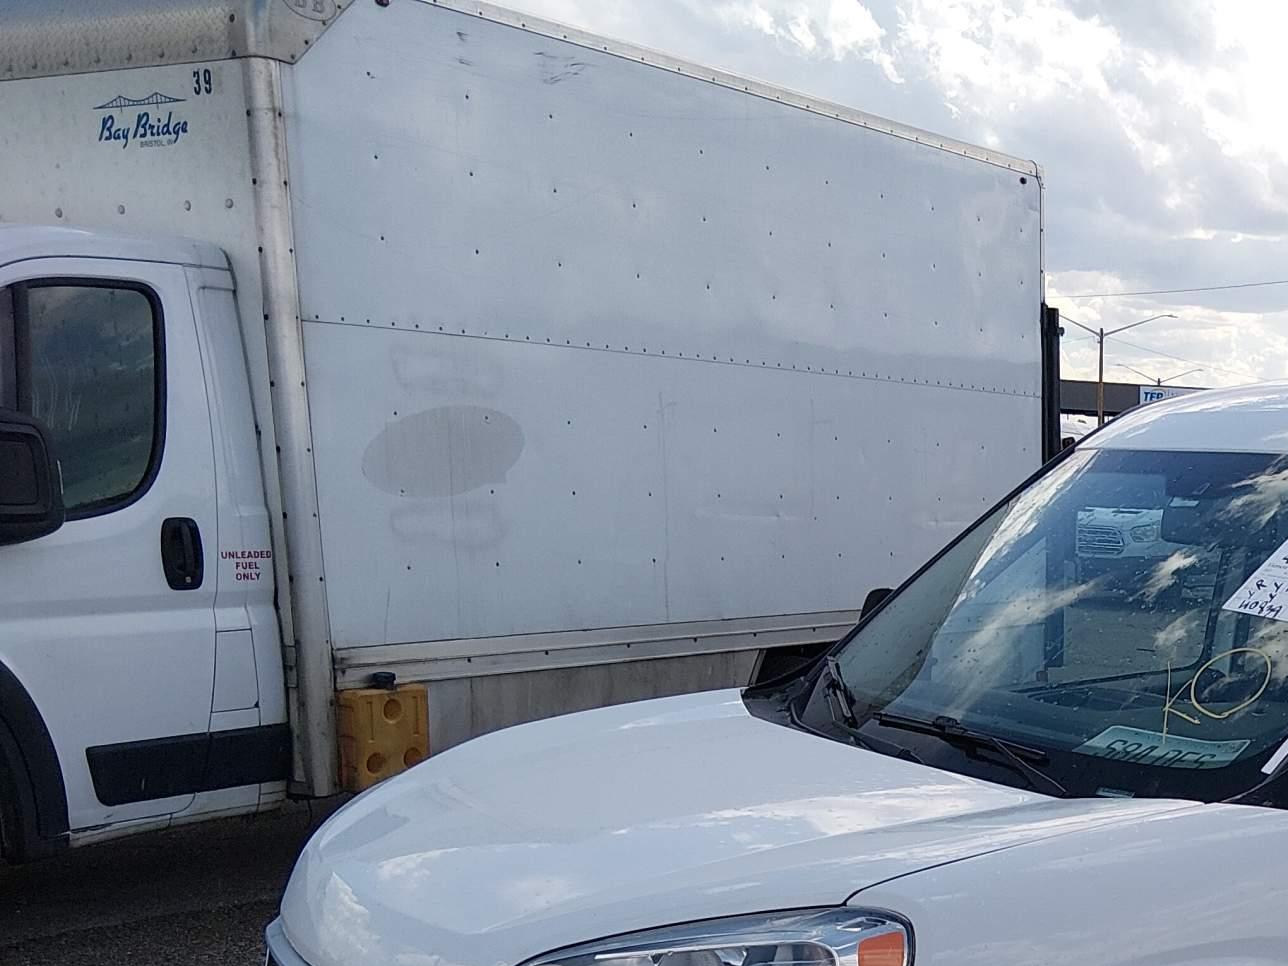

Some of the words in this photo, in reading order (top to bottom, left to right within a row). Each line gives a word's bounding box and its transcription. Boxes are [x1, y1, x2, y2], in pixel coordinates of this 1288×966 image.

[192, 68, 212, 95] 39
[98, 114, 130, 149] Bay
[133, 111, 188, 144] Bridge
[220, 550, 272, 559] UNLEADED
[235, 561, 261, 570] FUEL
[235, 572, 261, 581] ONLY
